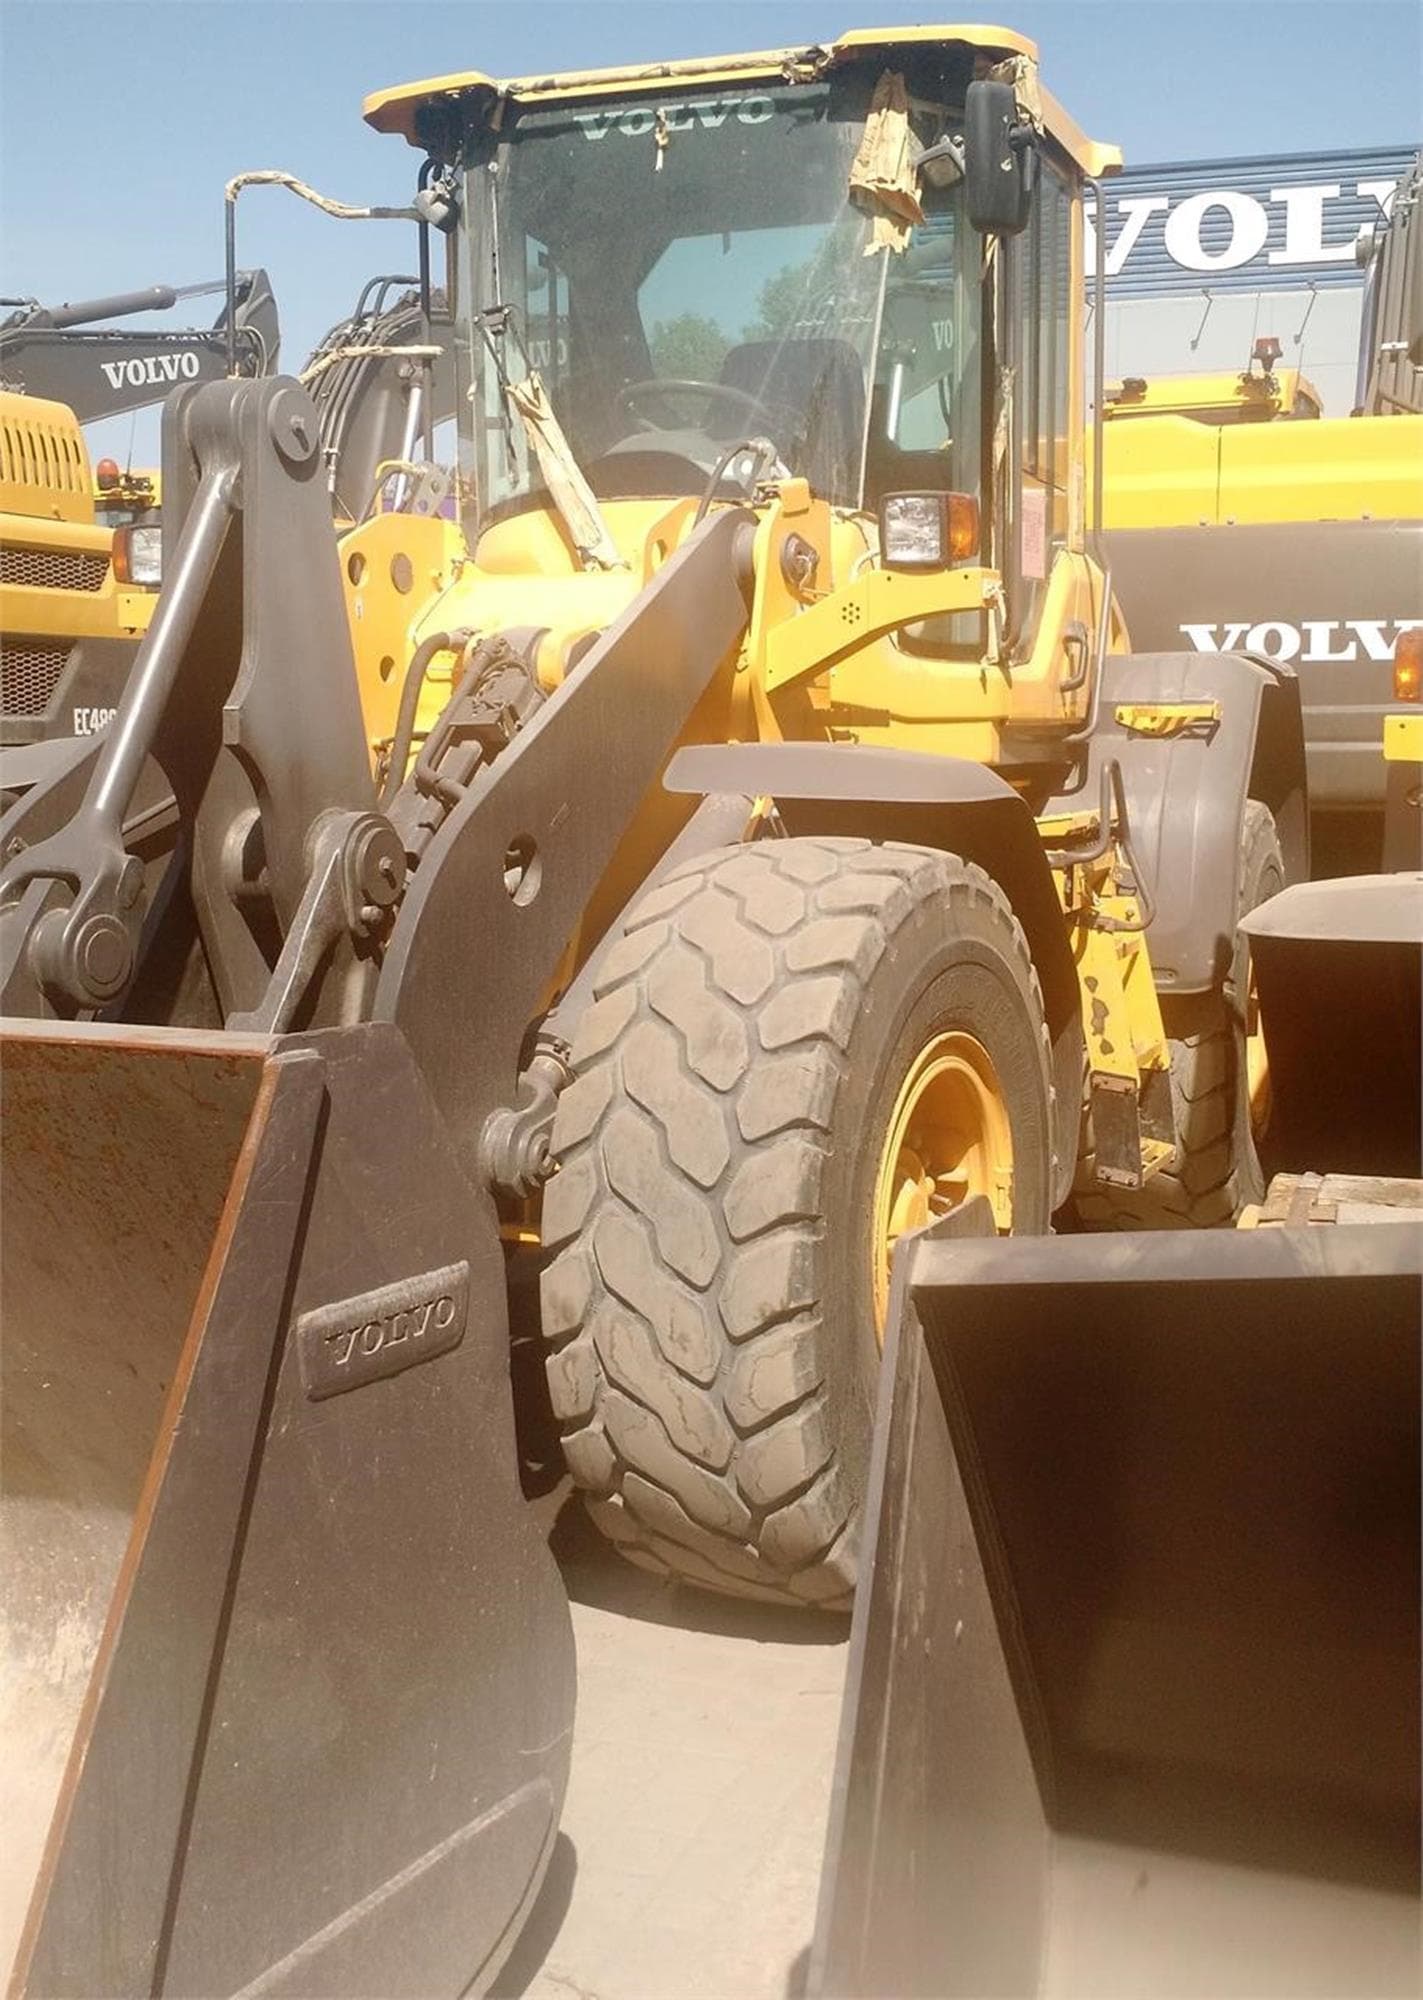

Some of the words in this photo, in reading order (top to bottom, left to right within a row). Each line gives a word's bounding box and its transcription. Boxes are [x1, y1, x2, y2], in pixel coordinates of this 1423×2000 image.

[573, 96, 775, 140] VOLVO
[101, 352, 199, 389] VOLVO
[325, 1296, 456, 1365] VOLVO
